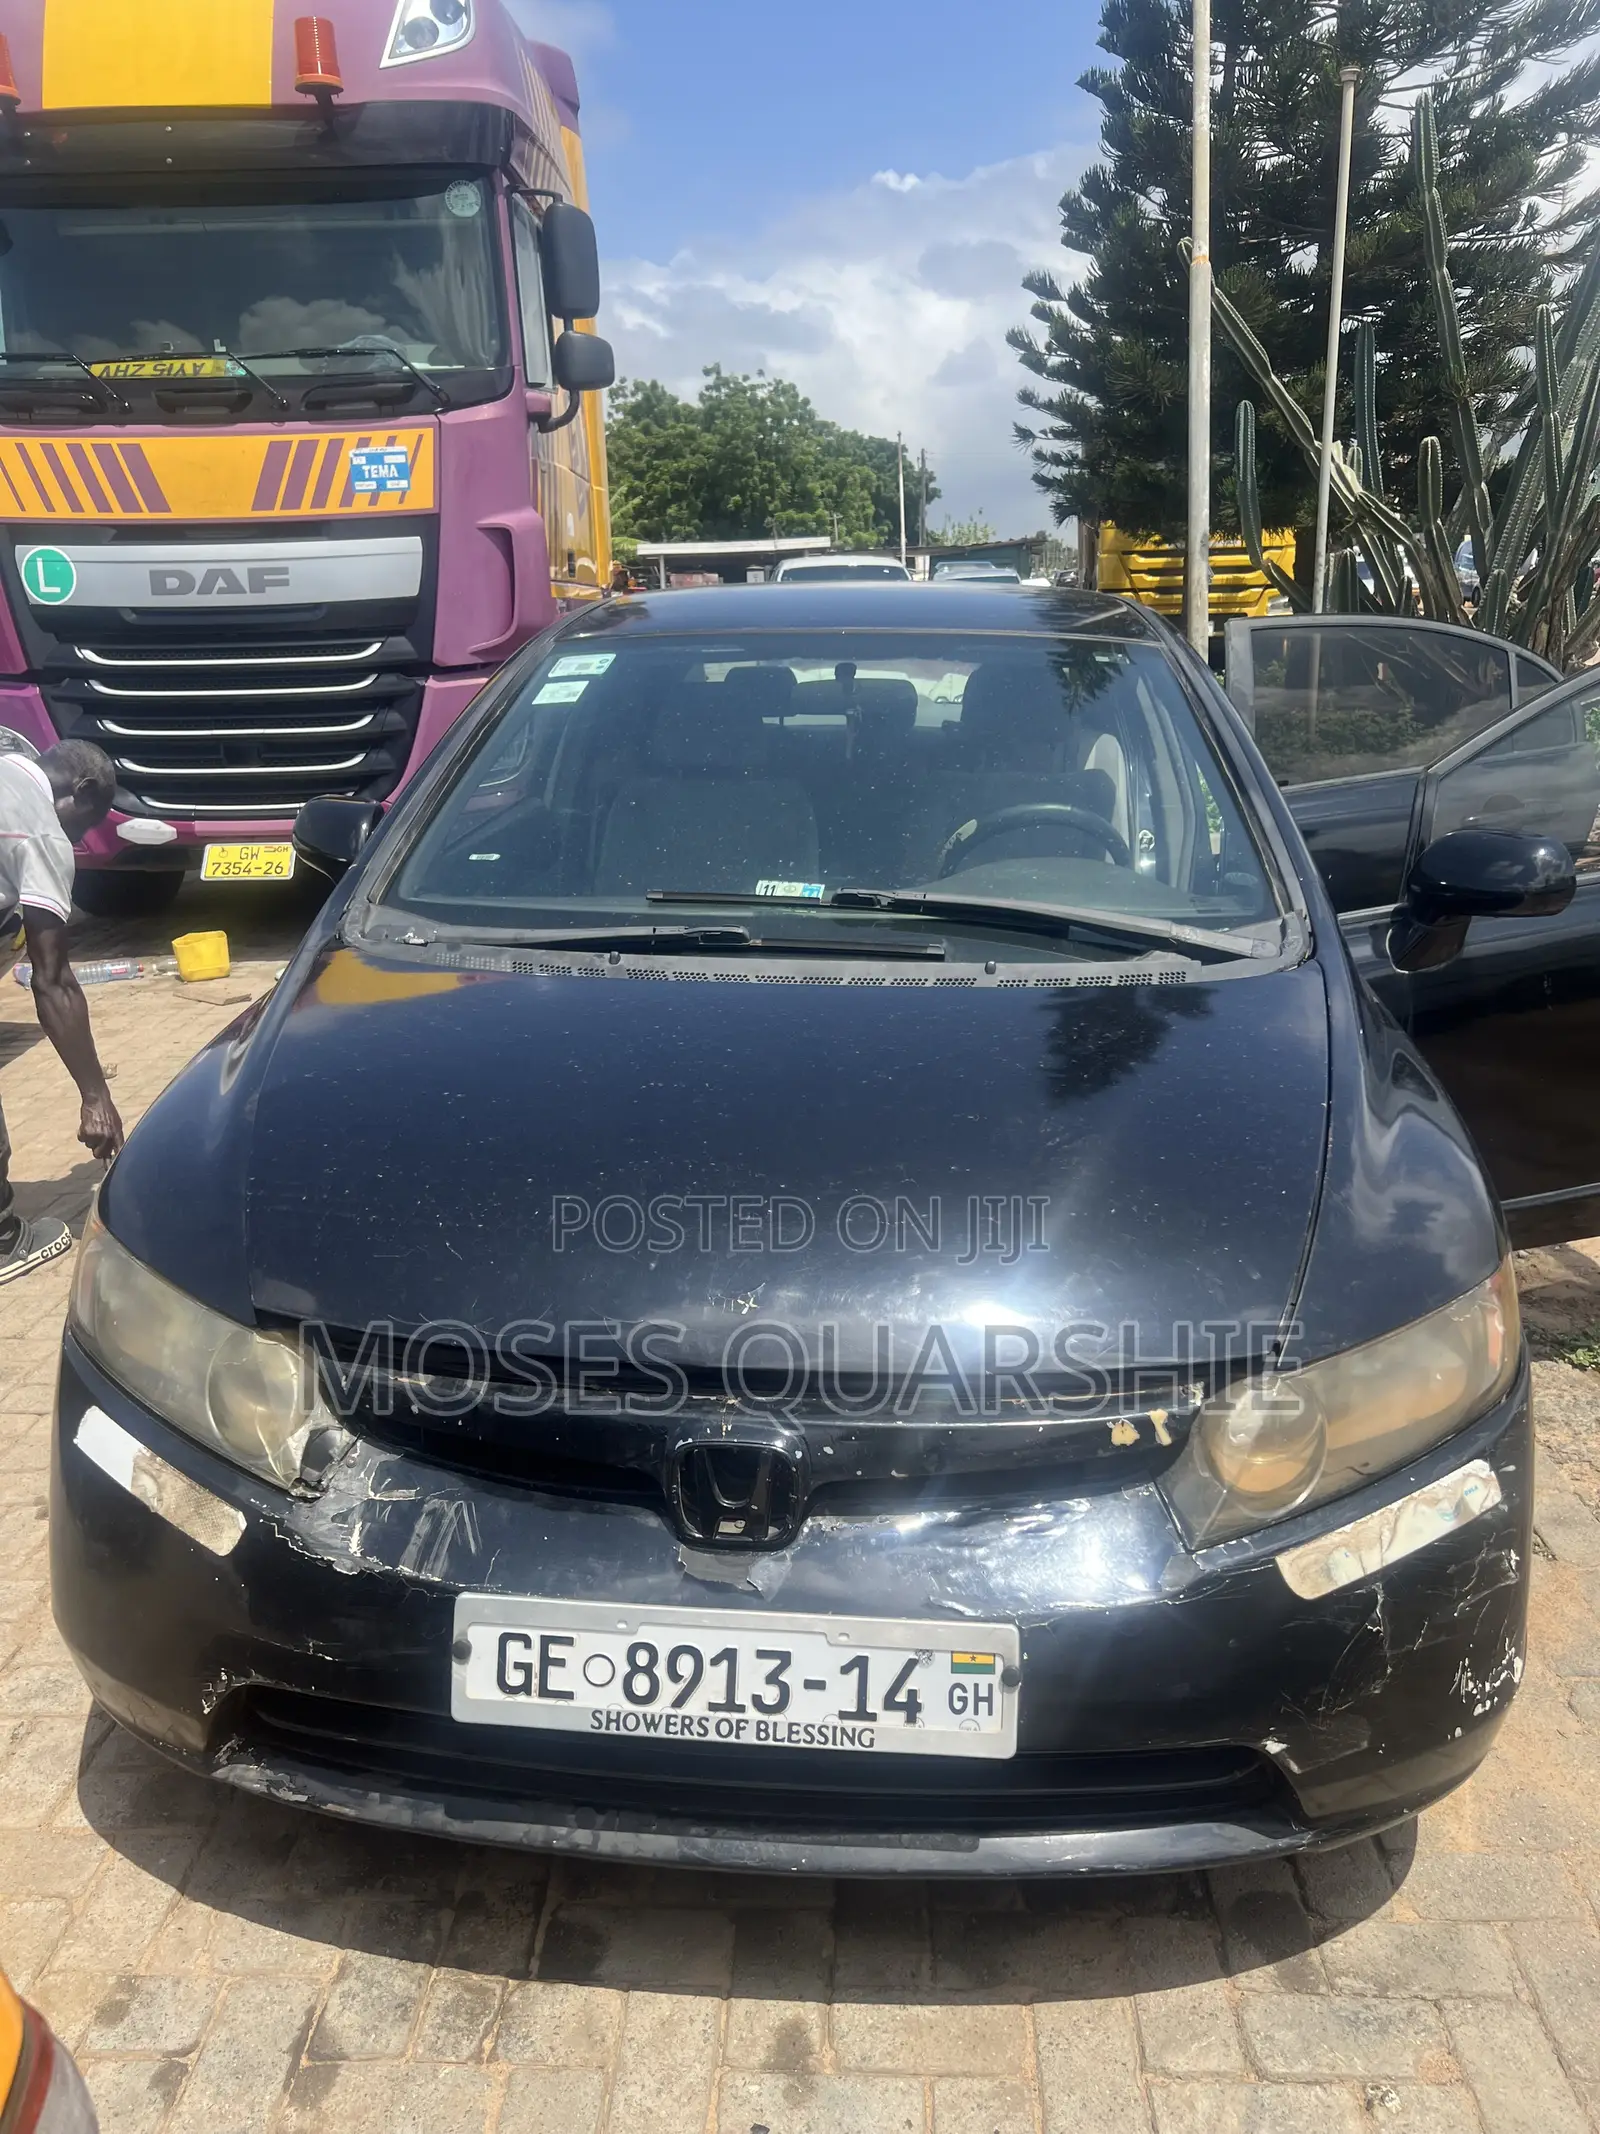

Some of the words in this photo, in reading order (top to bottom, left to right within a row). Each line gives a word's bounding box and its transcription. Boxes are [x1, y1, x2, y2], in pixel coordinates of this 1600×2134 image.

[361, 464, 399, 479] TEMA
[36, 557, 61, 593] L
[149, 566, 290, 596] DAF
[212, 861, 284, 876] 7354-26
[239, 846, 260, 860] GW
[496, 1631, 576, 1700] GE
[622, 1641, 923, 1724] 8913-14
[947, 1682, 994, 1716] GH
[590, 1709, 709, 1738] SHOWERS
[714, 1718, 749, 1740] OF
[755, 1720, 876, 1749] BLESSING
